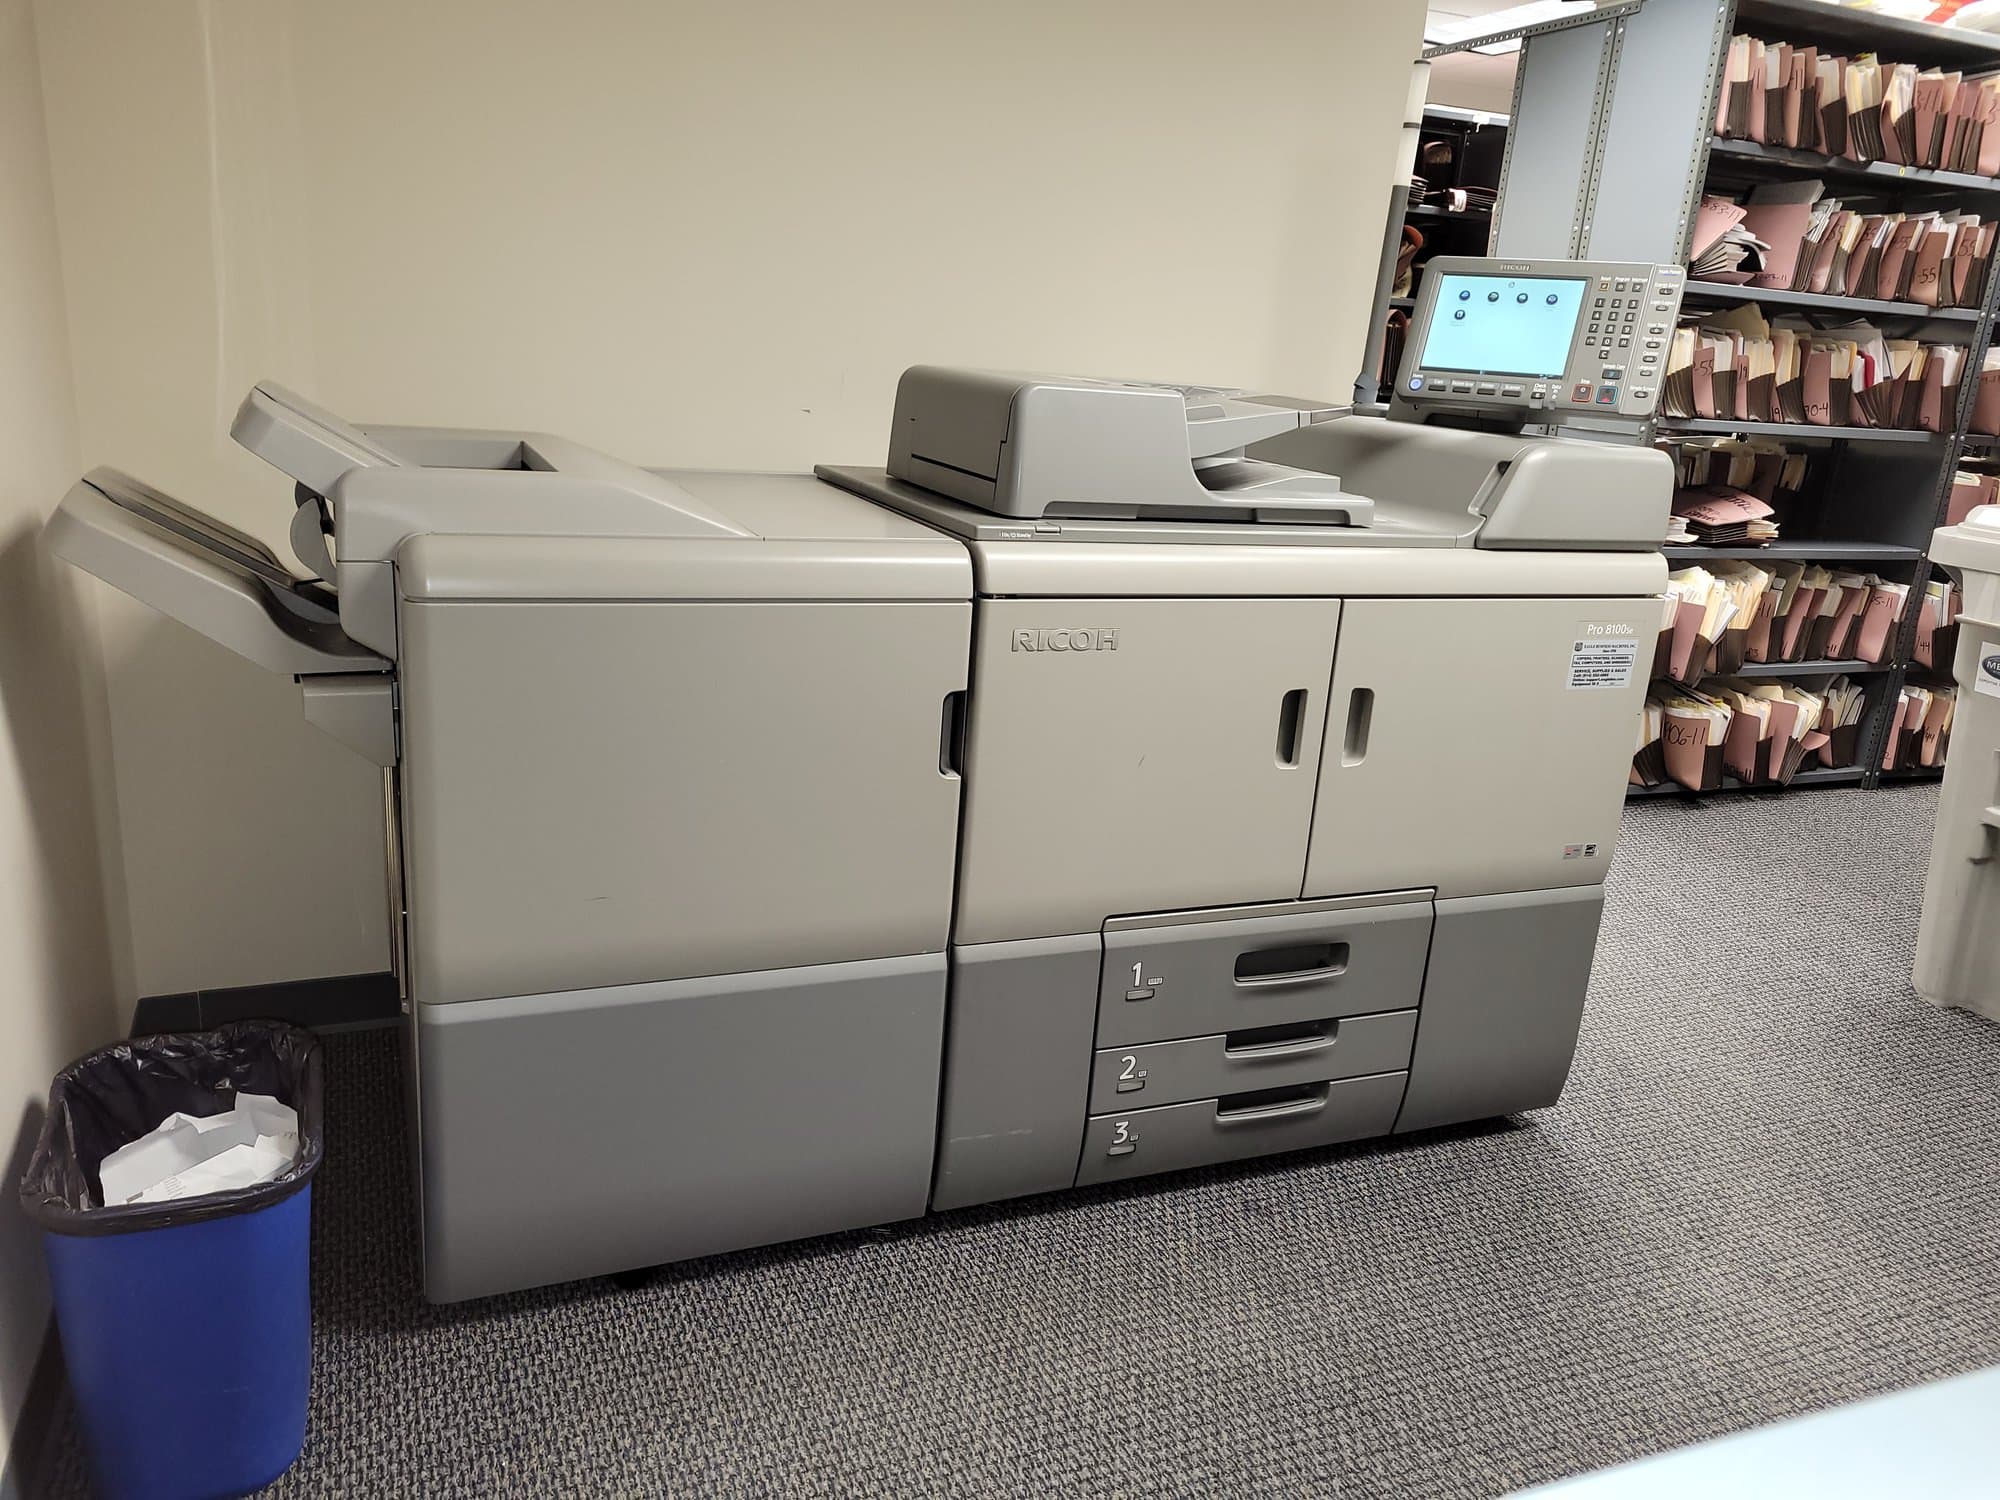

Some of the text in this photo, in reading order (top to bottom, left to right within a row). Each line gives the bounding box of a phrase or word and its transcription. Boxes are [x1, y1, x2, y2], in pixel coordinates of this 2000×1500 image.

[1011, 627, 1121, 652] RICOH
[1587, 623, 1604, 635] Pro
[1132, 961, 1143, 987] 1
[1119, 1055, 1137, 1080] 2
[1112, 1120, 1129, 1145] 3
